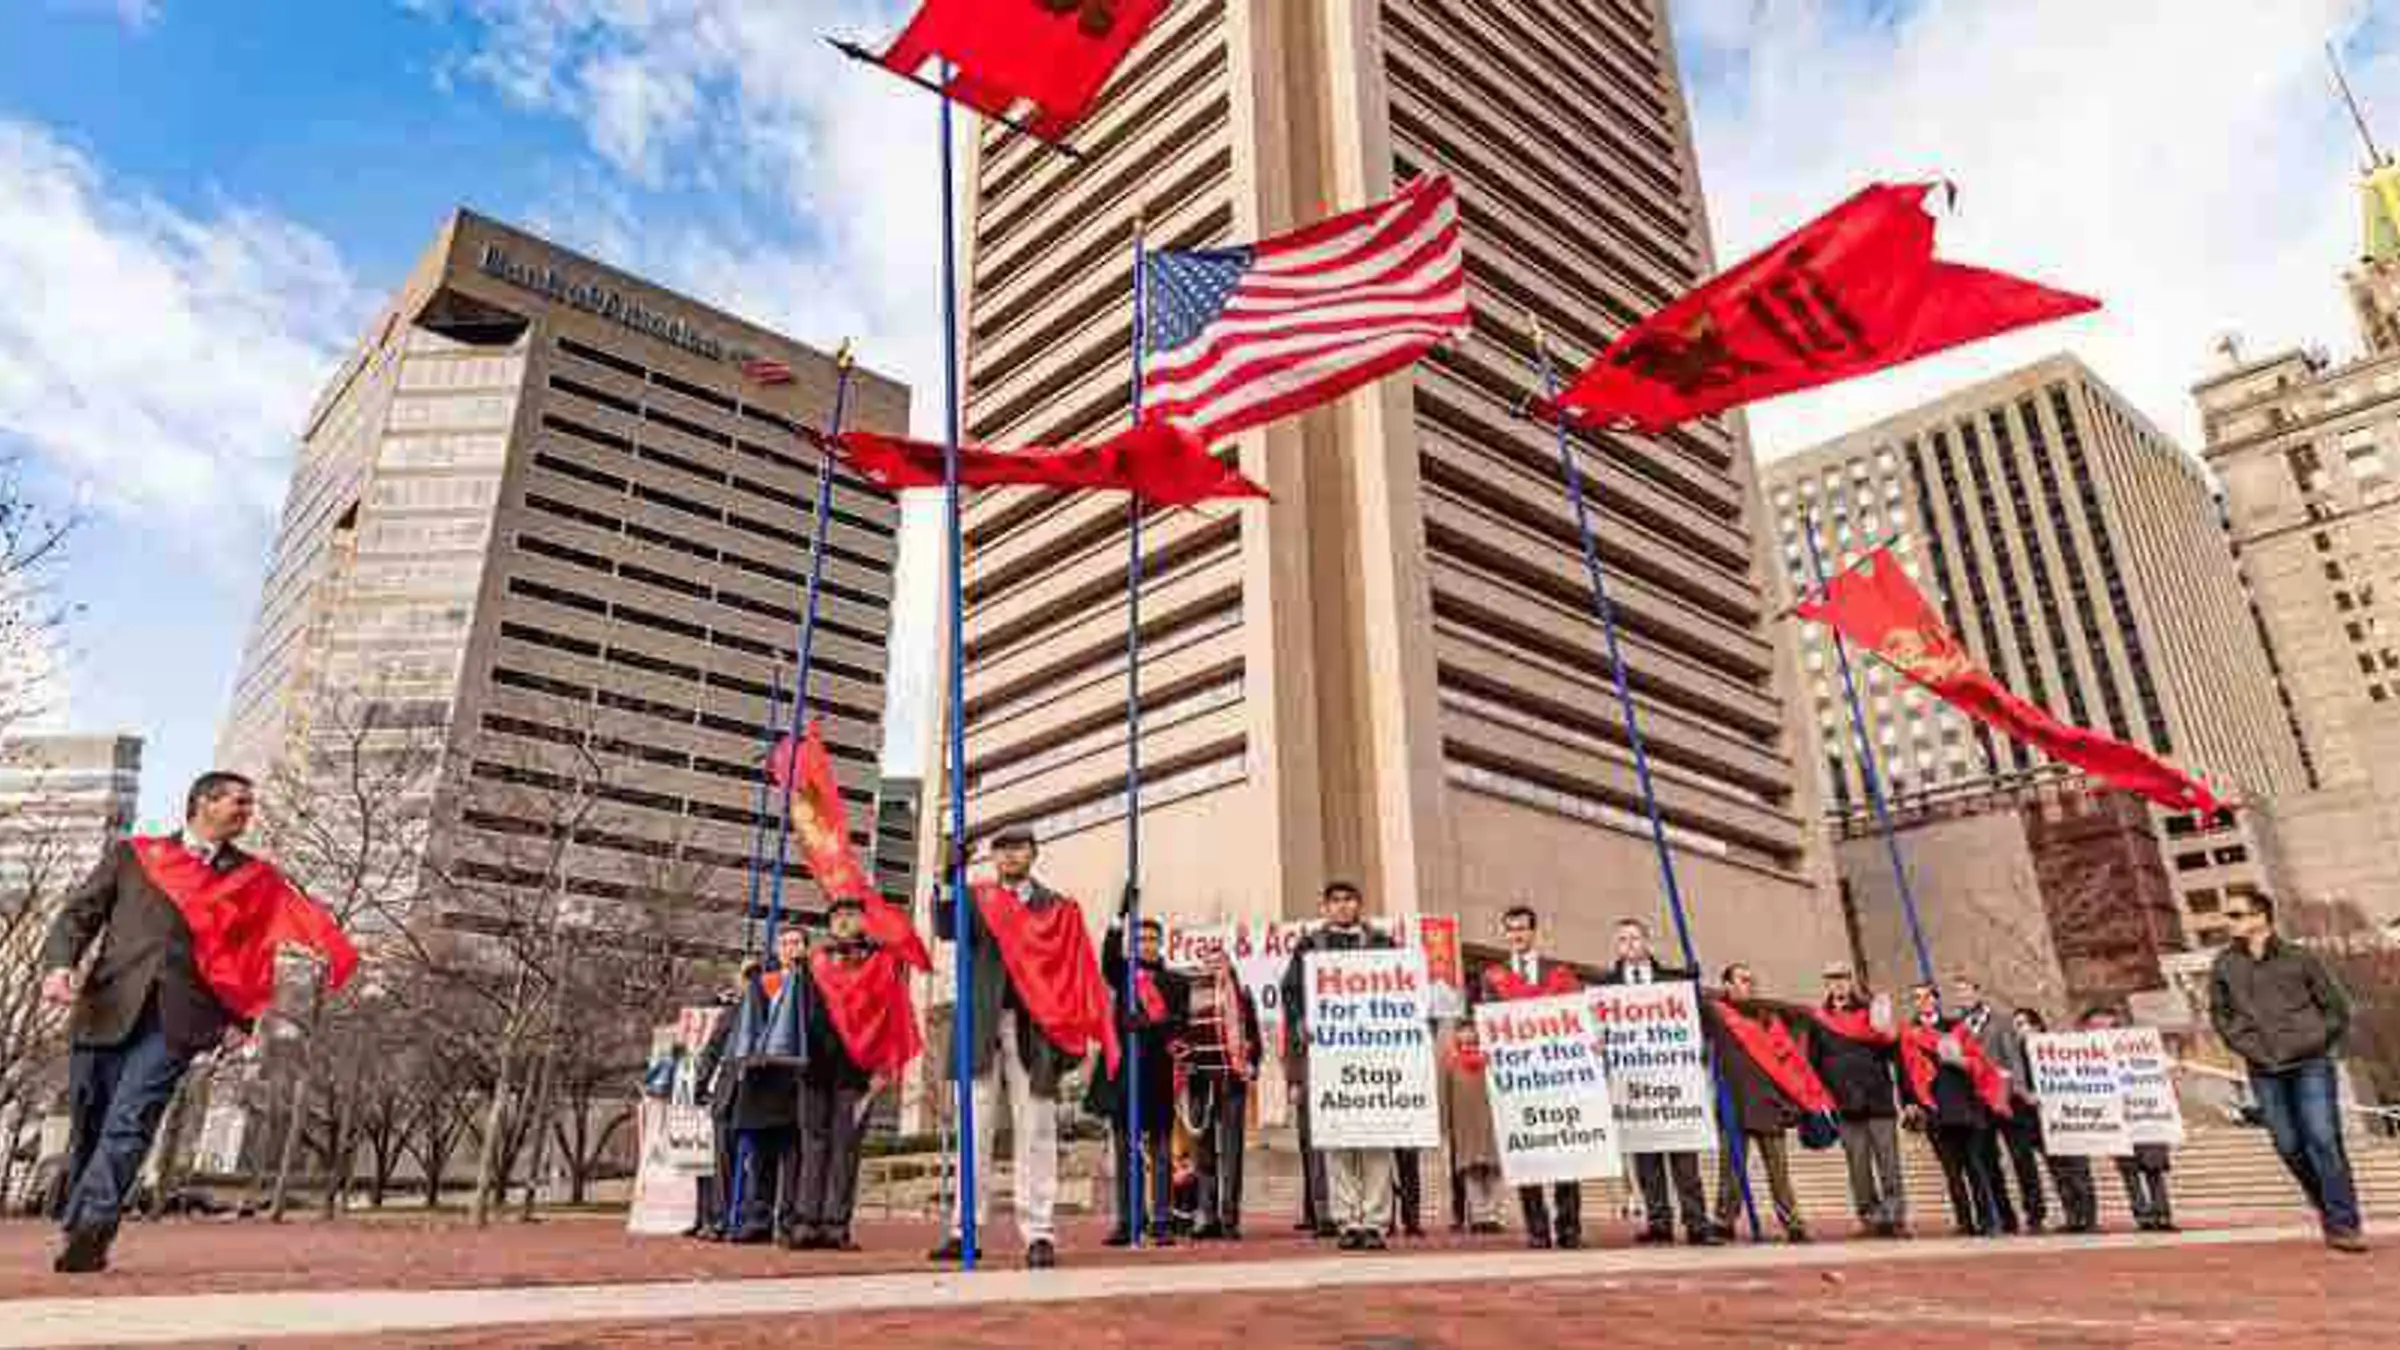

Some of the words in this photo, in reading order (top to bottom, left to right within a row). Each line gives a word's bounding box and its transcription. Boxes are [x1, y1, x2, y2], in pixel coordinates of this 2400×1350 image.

[1316, 964, 1416, 994] Honk
[1319, 1000, 1360, 1020] for
[1369, 997, 1415, 1019] the
[1598, 996, 1688, 1023] Honk
[1316, 1025, 1423, 1047] Unborn
[1486, 1008, 1583, 1041] Honk
[1604, 1024, 1638, 1044] for
[1648, 1020, 1689, 1043] the
[1494, 1045, 1531, 1067] for
[1541, 1040, 1586, 1062] the
[2037, 1040, 2108, 1061] Honk
[1340, 1064, 1402, 1089] Stop
[1492, 1064, 1597, 1093] Unborn
[2076, 1064, 2108, 1078] the
[1628, 1081, 1682, 1102] Stop
[2039, 1079, 2116, 1095] Unborn
[1319, 1090, 1427, 1110] Abortion
[2061, 1103, 2104, 1118] Stop
[1522, 1104, 1581, 1129] Stop
[1507, 1127, 1606, 1152] Abortion
